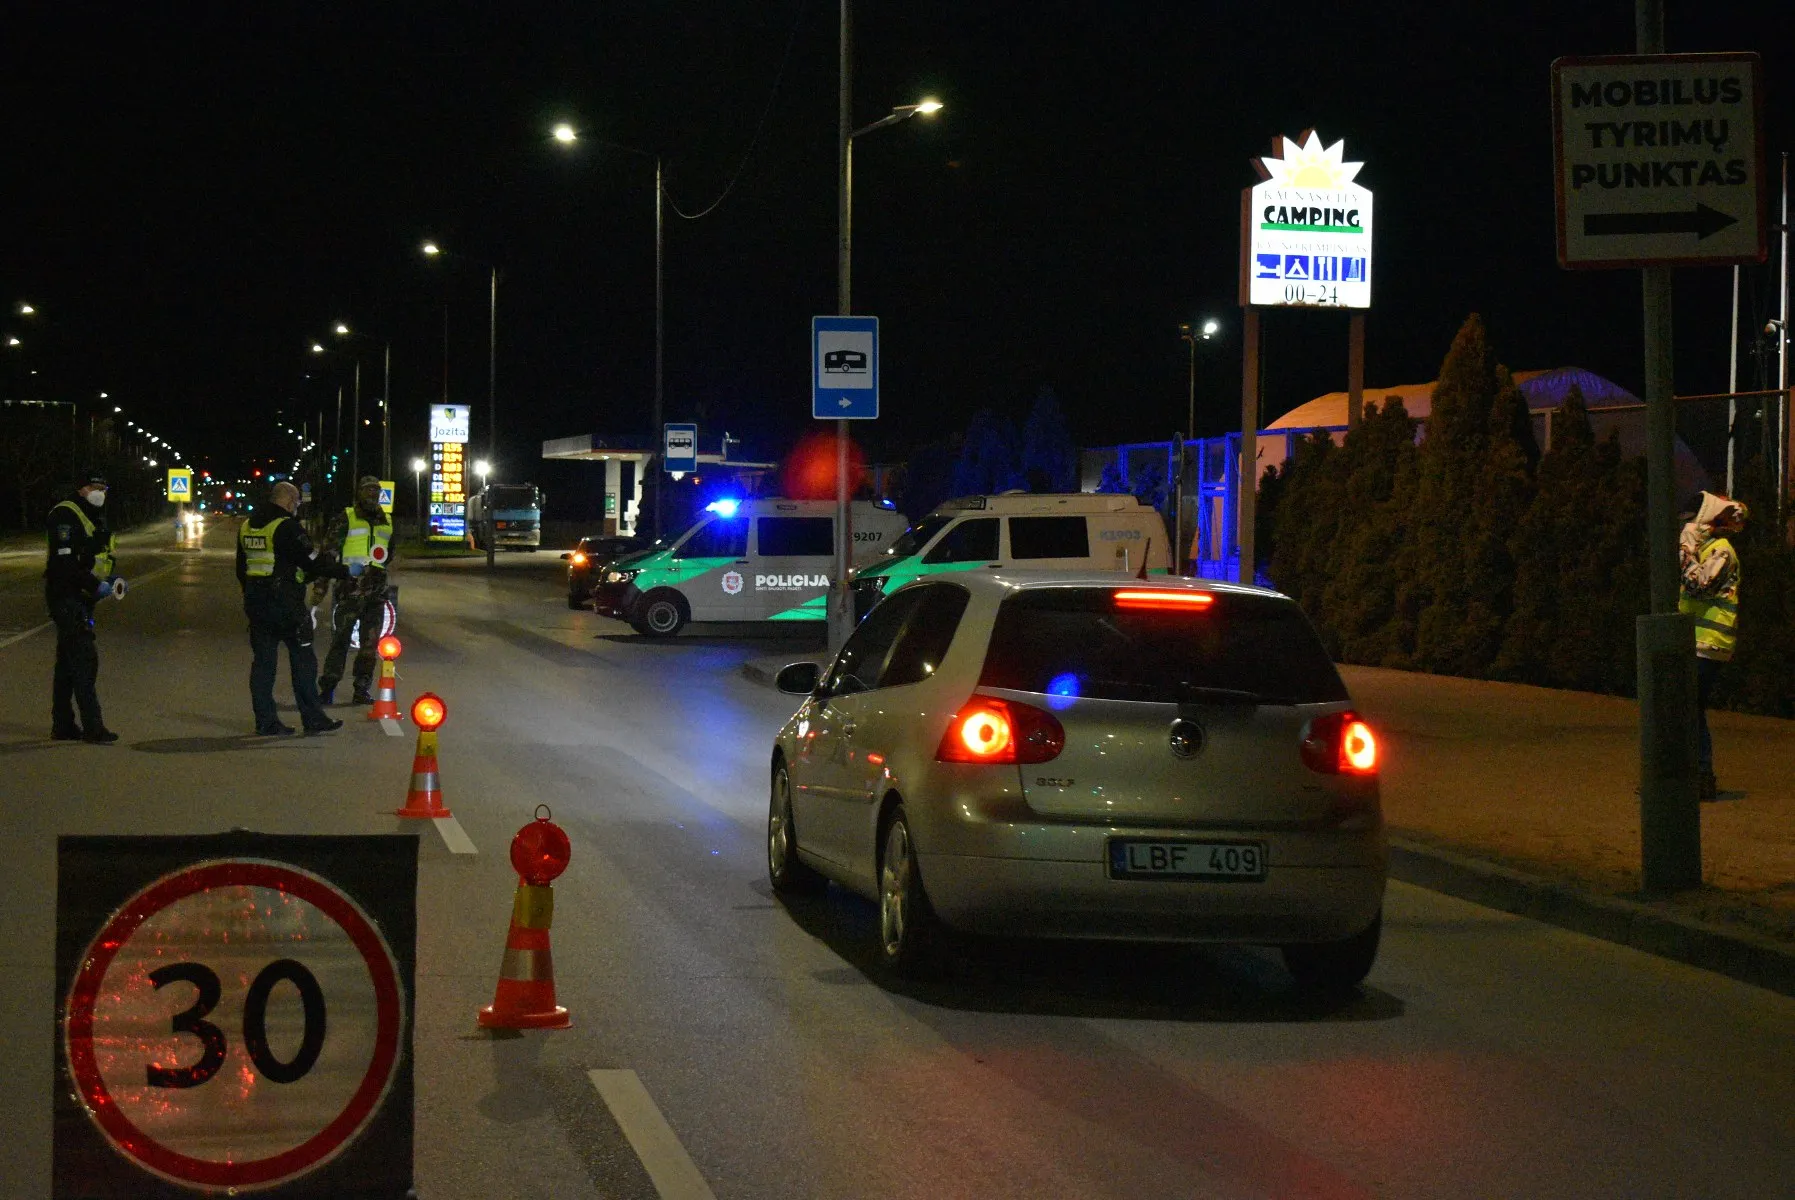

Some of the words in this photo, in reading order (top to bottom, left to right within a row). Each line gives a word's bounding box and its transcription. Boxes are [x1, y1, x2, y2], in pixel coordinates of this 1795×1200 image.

[1570, 77, 1743, 108] MOBILUS
[1585, 119, 1728, 154] TYRIMŲ
[1571, 158, 1747, 190] PUNKTAS
[1263, 205, 1360, 228] CAMPING
[434, 426, 466, 438] Jozita
[755, 574, 830, 587] POLICIJA
[1129, 846, 1188, 870] LBF
[1208, 848, 1256, 872] 409
[145, 958, 327, 1089] 30
